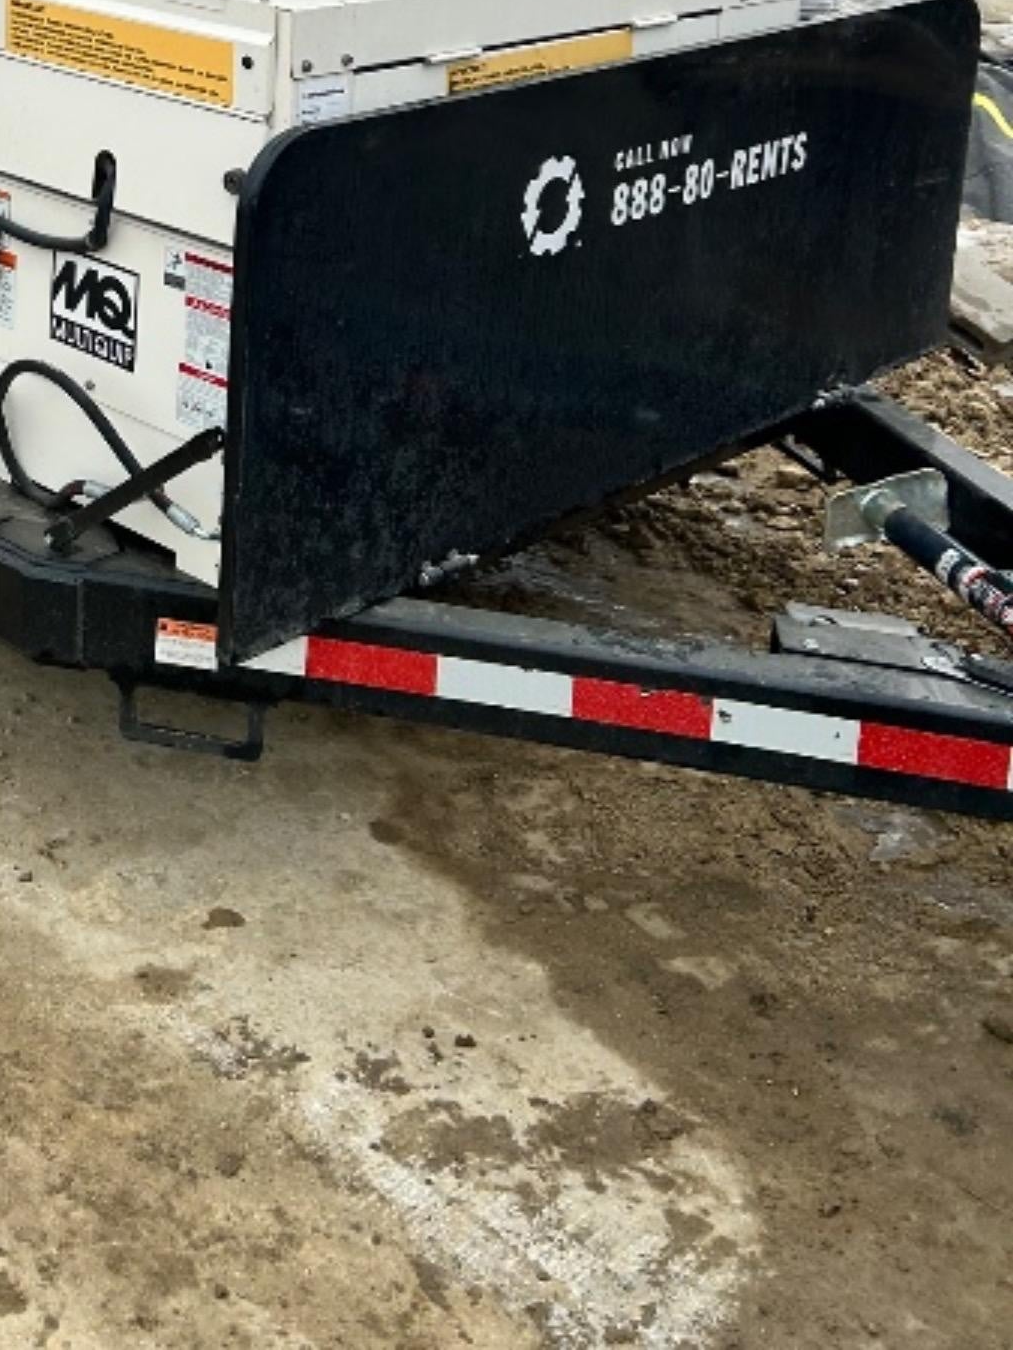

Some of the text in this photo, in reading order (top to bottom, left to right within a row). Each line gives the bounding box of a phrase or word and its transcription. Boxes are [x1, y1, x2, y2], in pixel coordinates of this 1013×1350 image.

[611, 131, 808, 226] 888-80-RENTS
[615, 142, 655, 172] CALL
[52, 260, 135, 339] MQ
